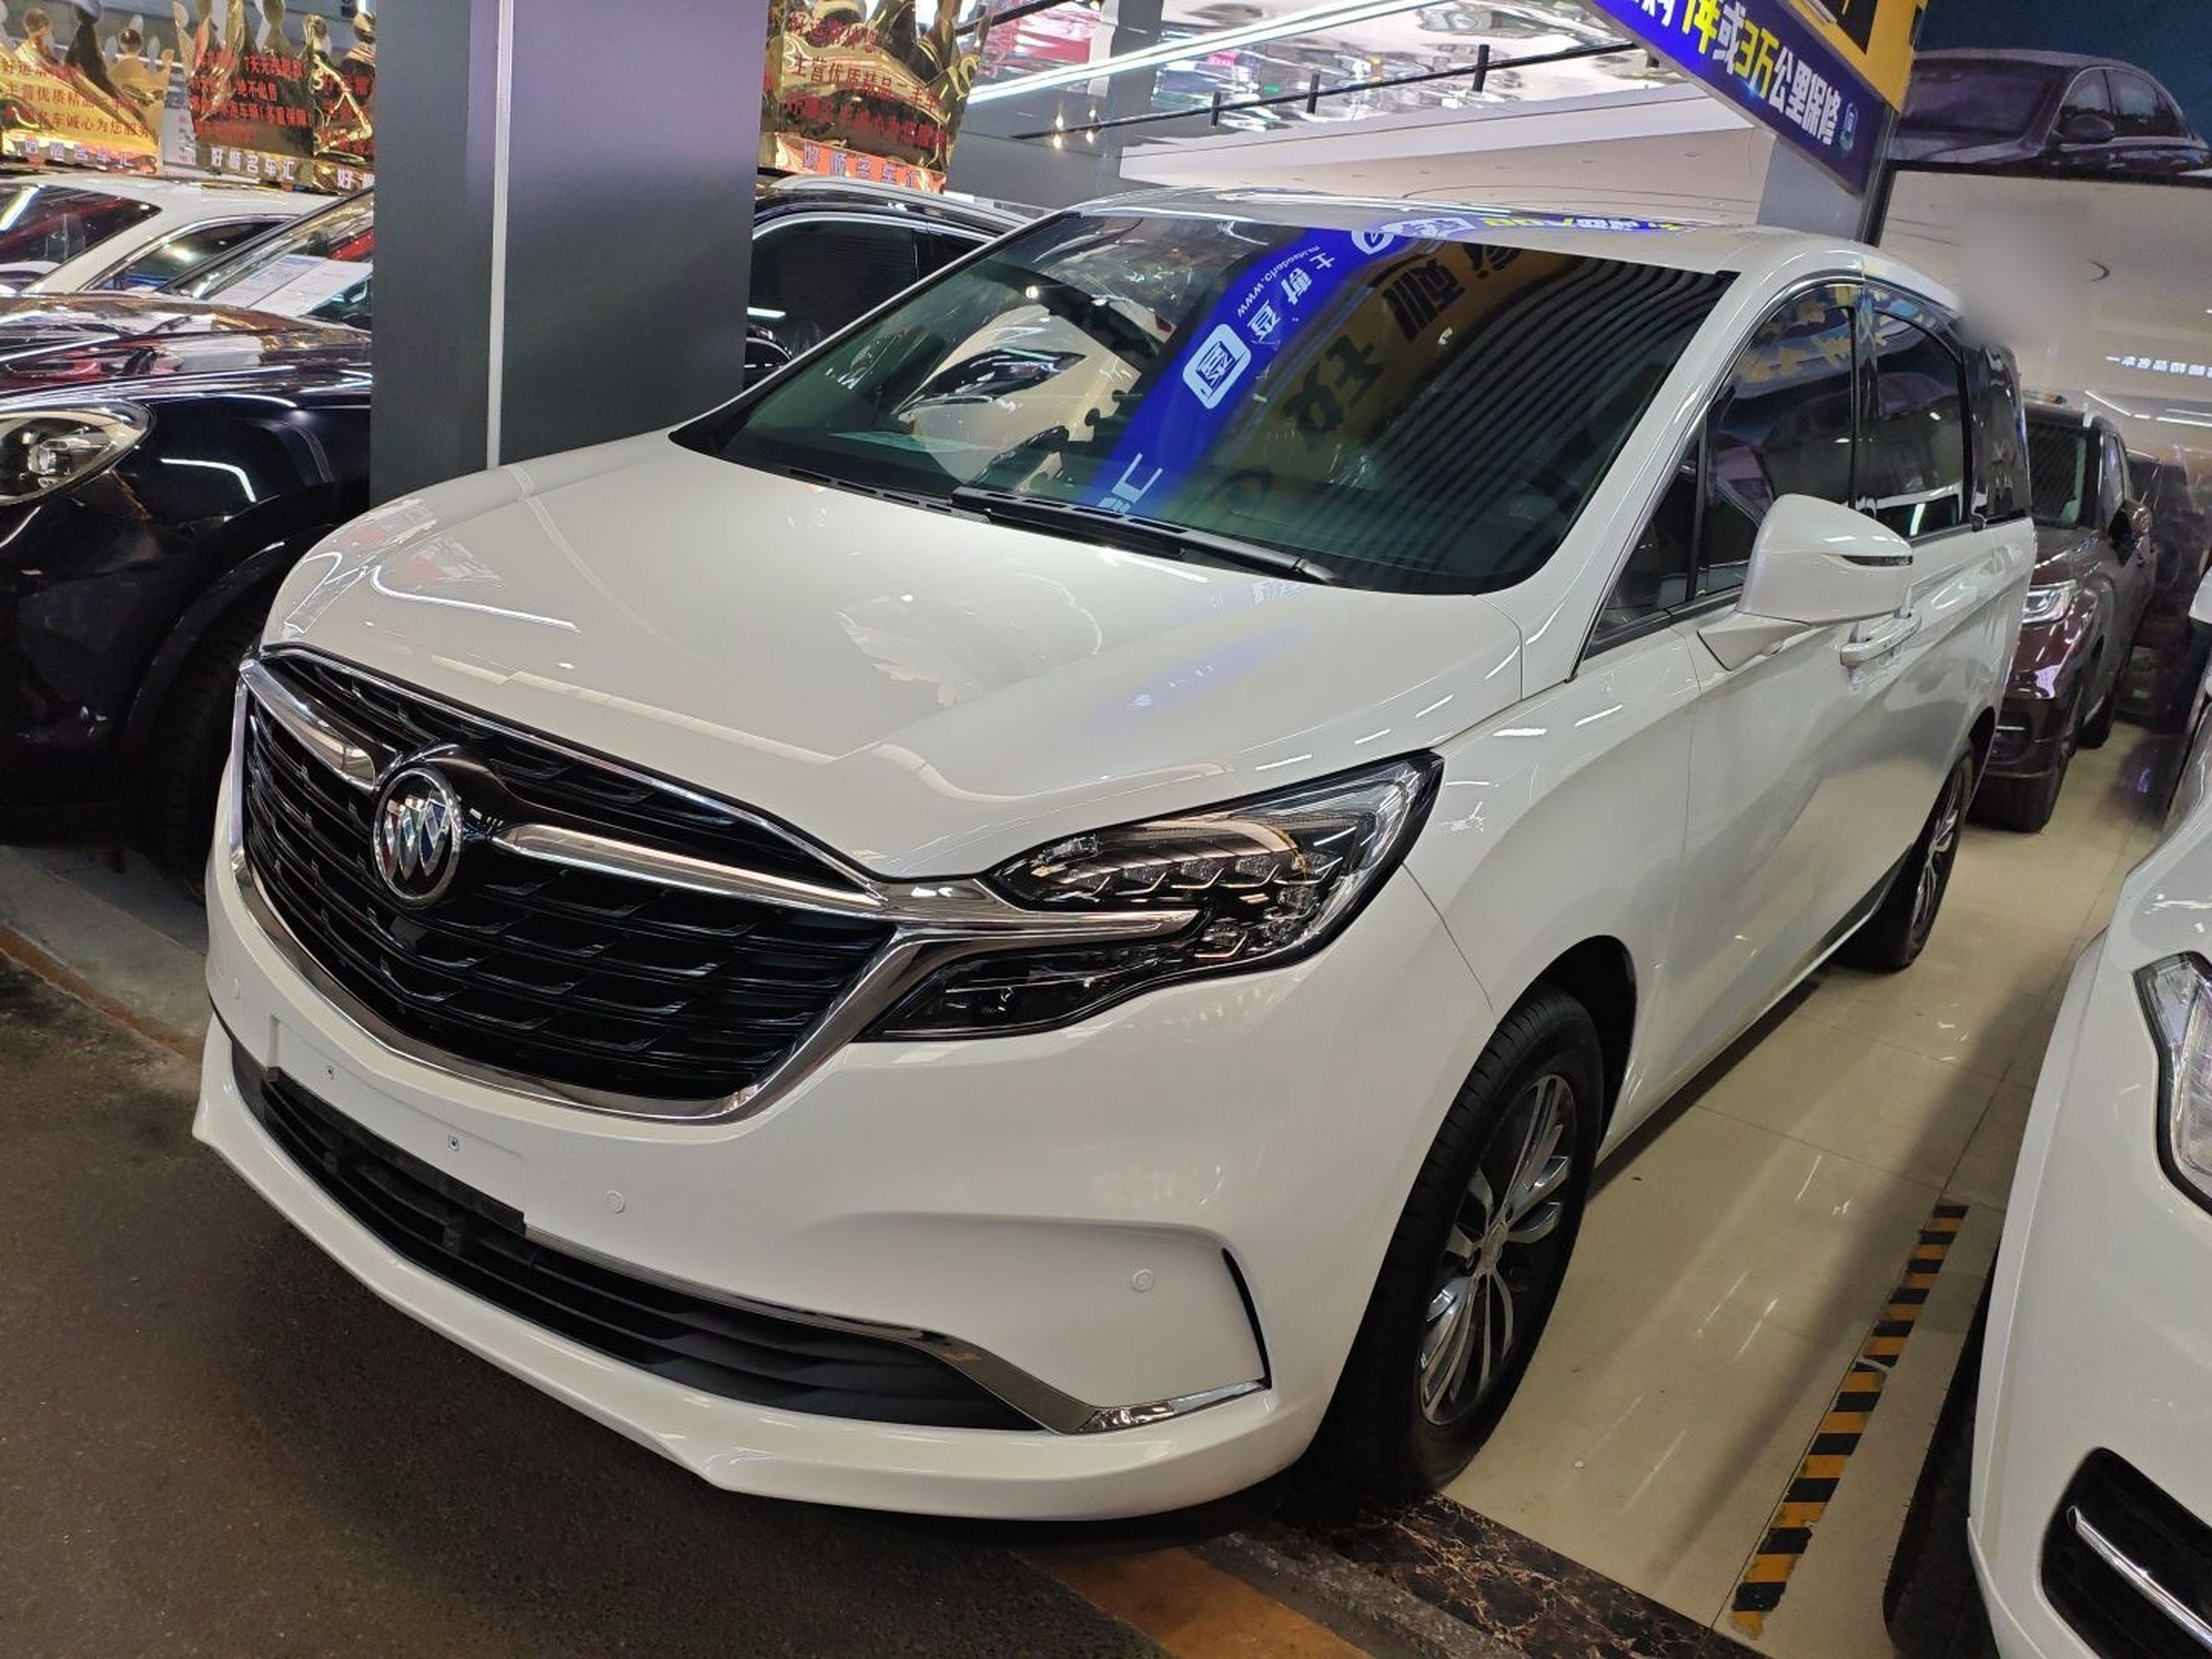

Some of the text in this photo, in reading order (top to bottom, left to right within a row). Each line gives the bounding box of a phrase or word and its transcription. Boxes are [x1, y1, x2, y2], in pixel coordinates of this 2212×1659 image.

[211, 146, 296, 181] 好顺名车汇
